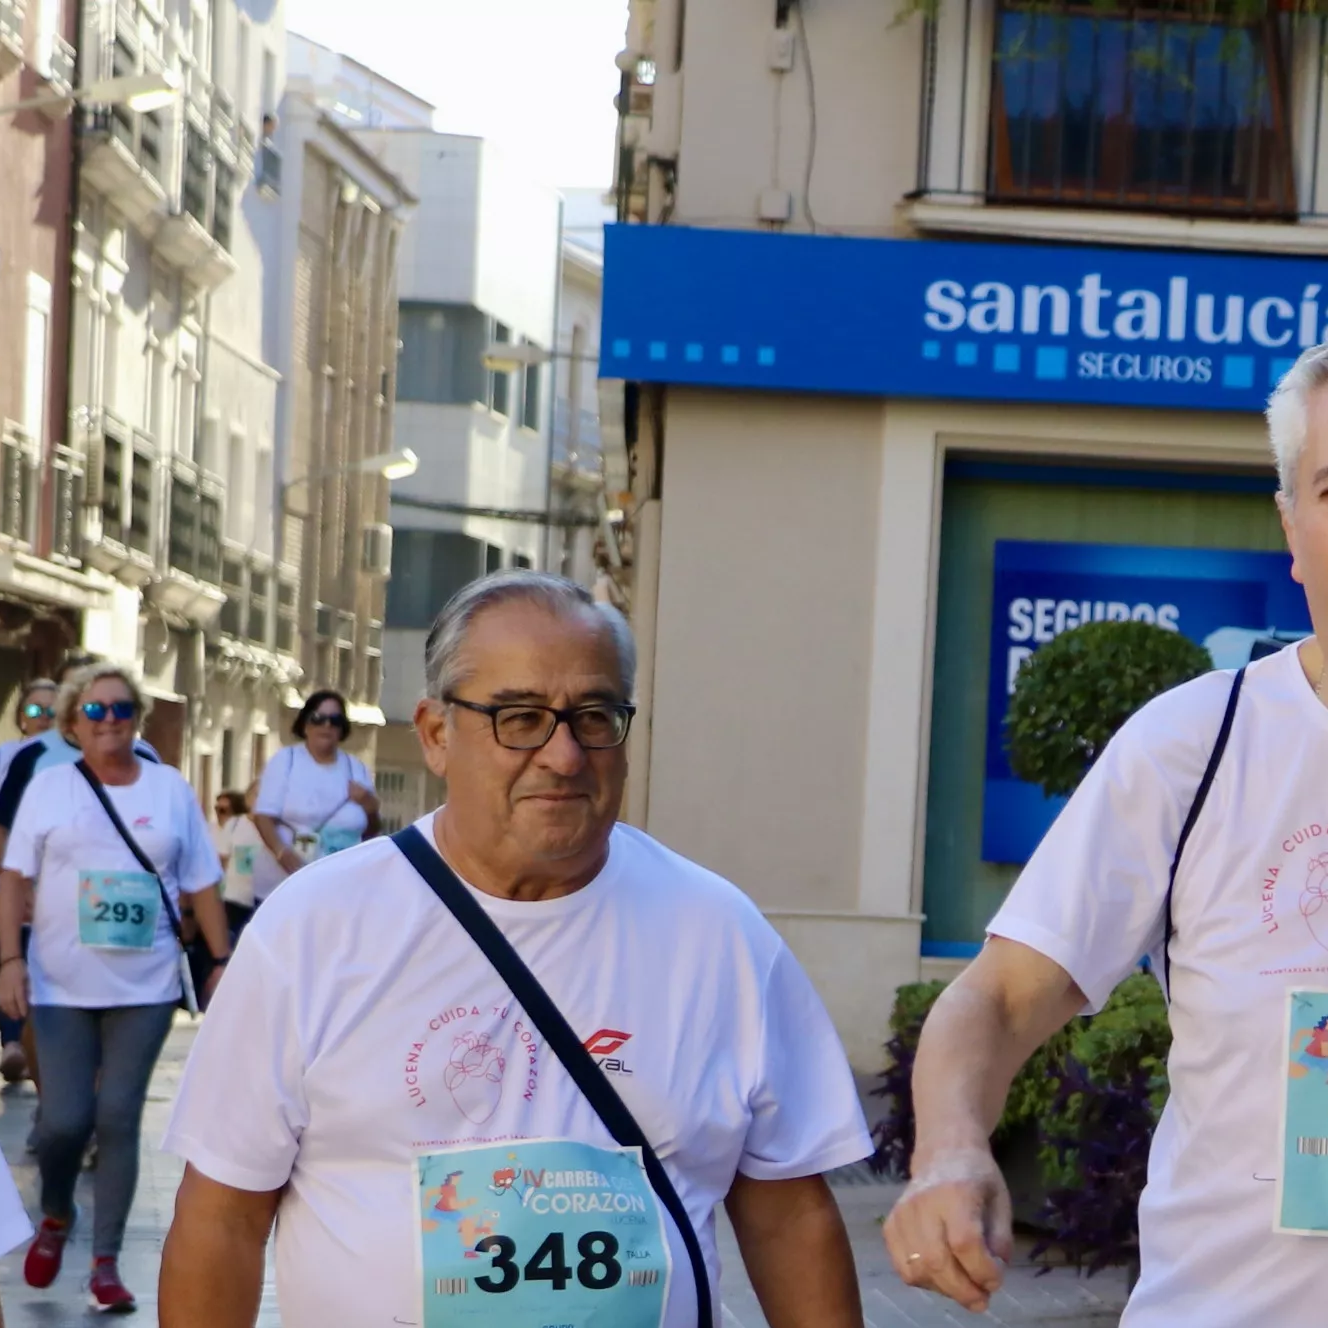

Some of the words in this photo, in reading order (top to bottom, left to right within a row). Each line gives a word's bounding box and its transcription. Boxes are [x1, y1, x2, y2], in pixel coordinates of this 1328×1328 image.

[1077, 352, 1213, 382] SEGUROS
[94, 901, 145, 926] 293
[429, 1005, 481, 1031] CUIDA
[524, 1168, 546, 1188] IV
[474, 1231, 622, 1294] 348
[626, 1249, 652, 1260] TALLA
